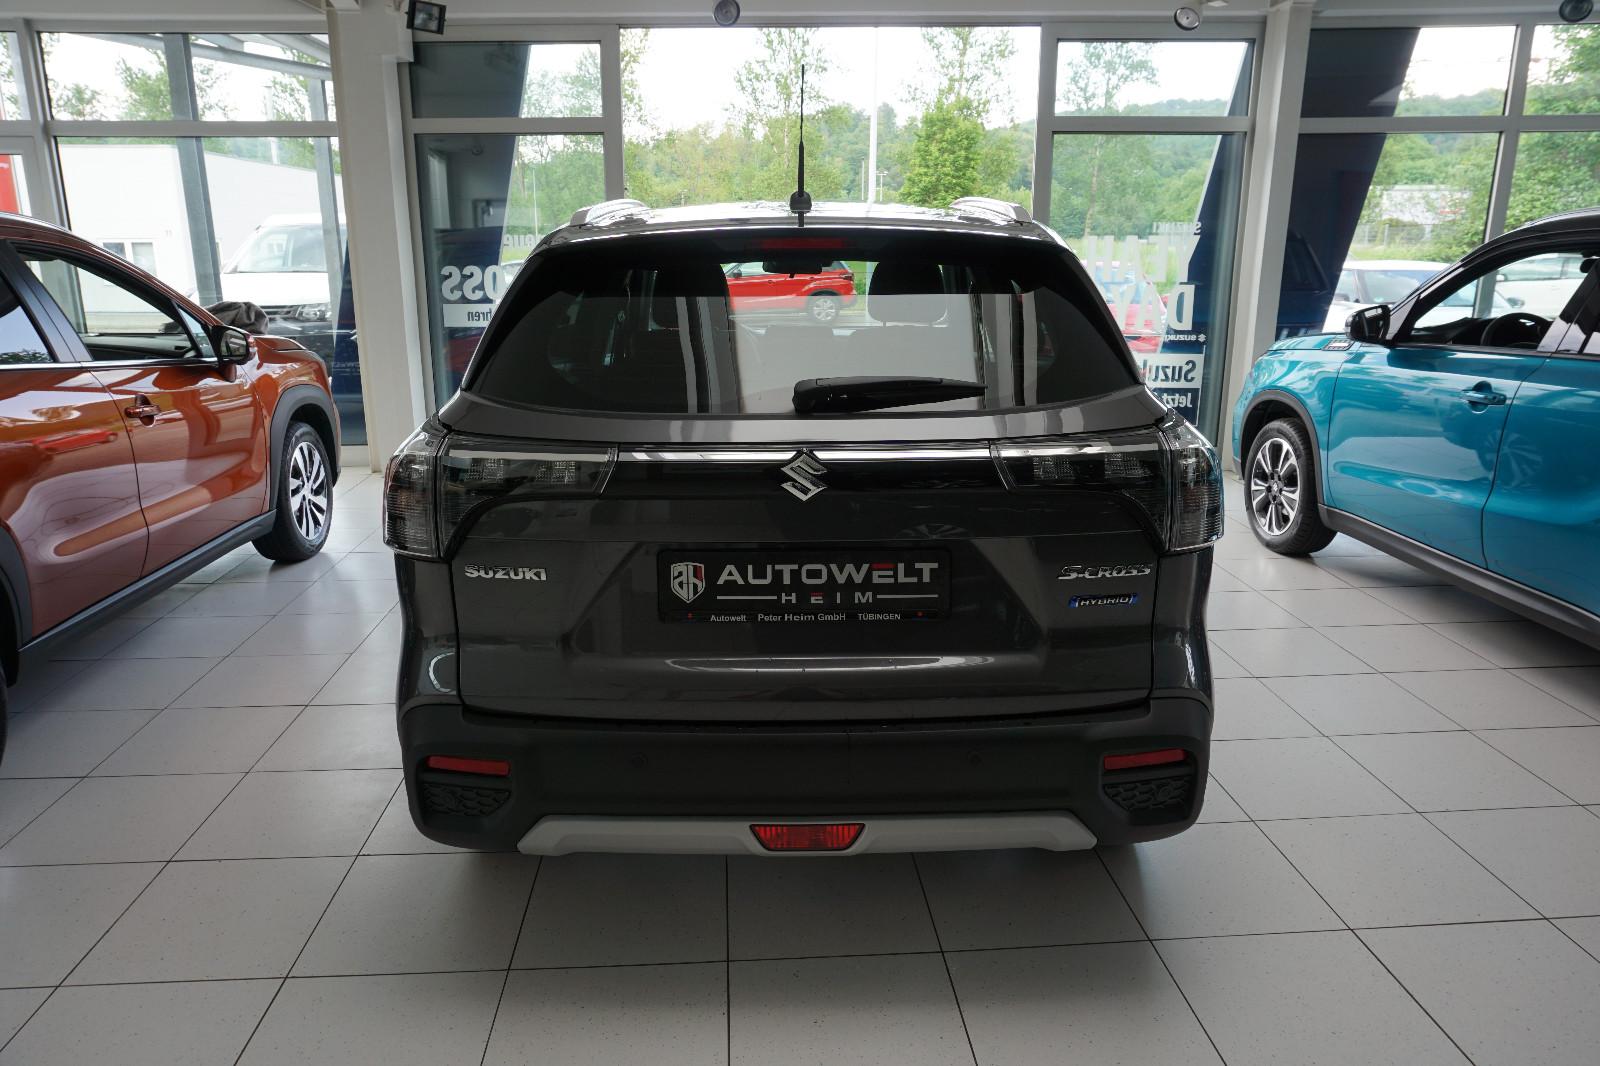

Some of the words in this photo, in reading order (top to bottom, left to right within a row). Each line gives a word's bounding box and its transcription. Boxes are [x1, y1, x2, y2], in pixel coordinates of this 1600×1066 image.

[464, 563, 548, 582] SUZUKI
[716, 562, 939, 585] AUTOWELT
[781, 592, 873, 604] HEIM
[1079, 596, 1130, 607] HYBRID
[710, 614, 747, 622] Autowelt
[757, 613, 782, 623] Peter
[784, 613, 815, 622] Heim
[816, 612, 846, 622] GmbH
[857, 611, 901, 622] TÜBINGEN
